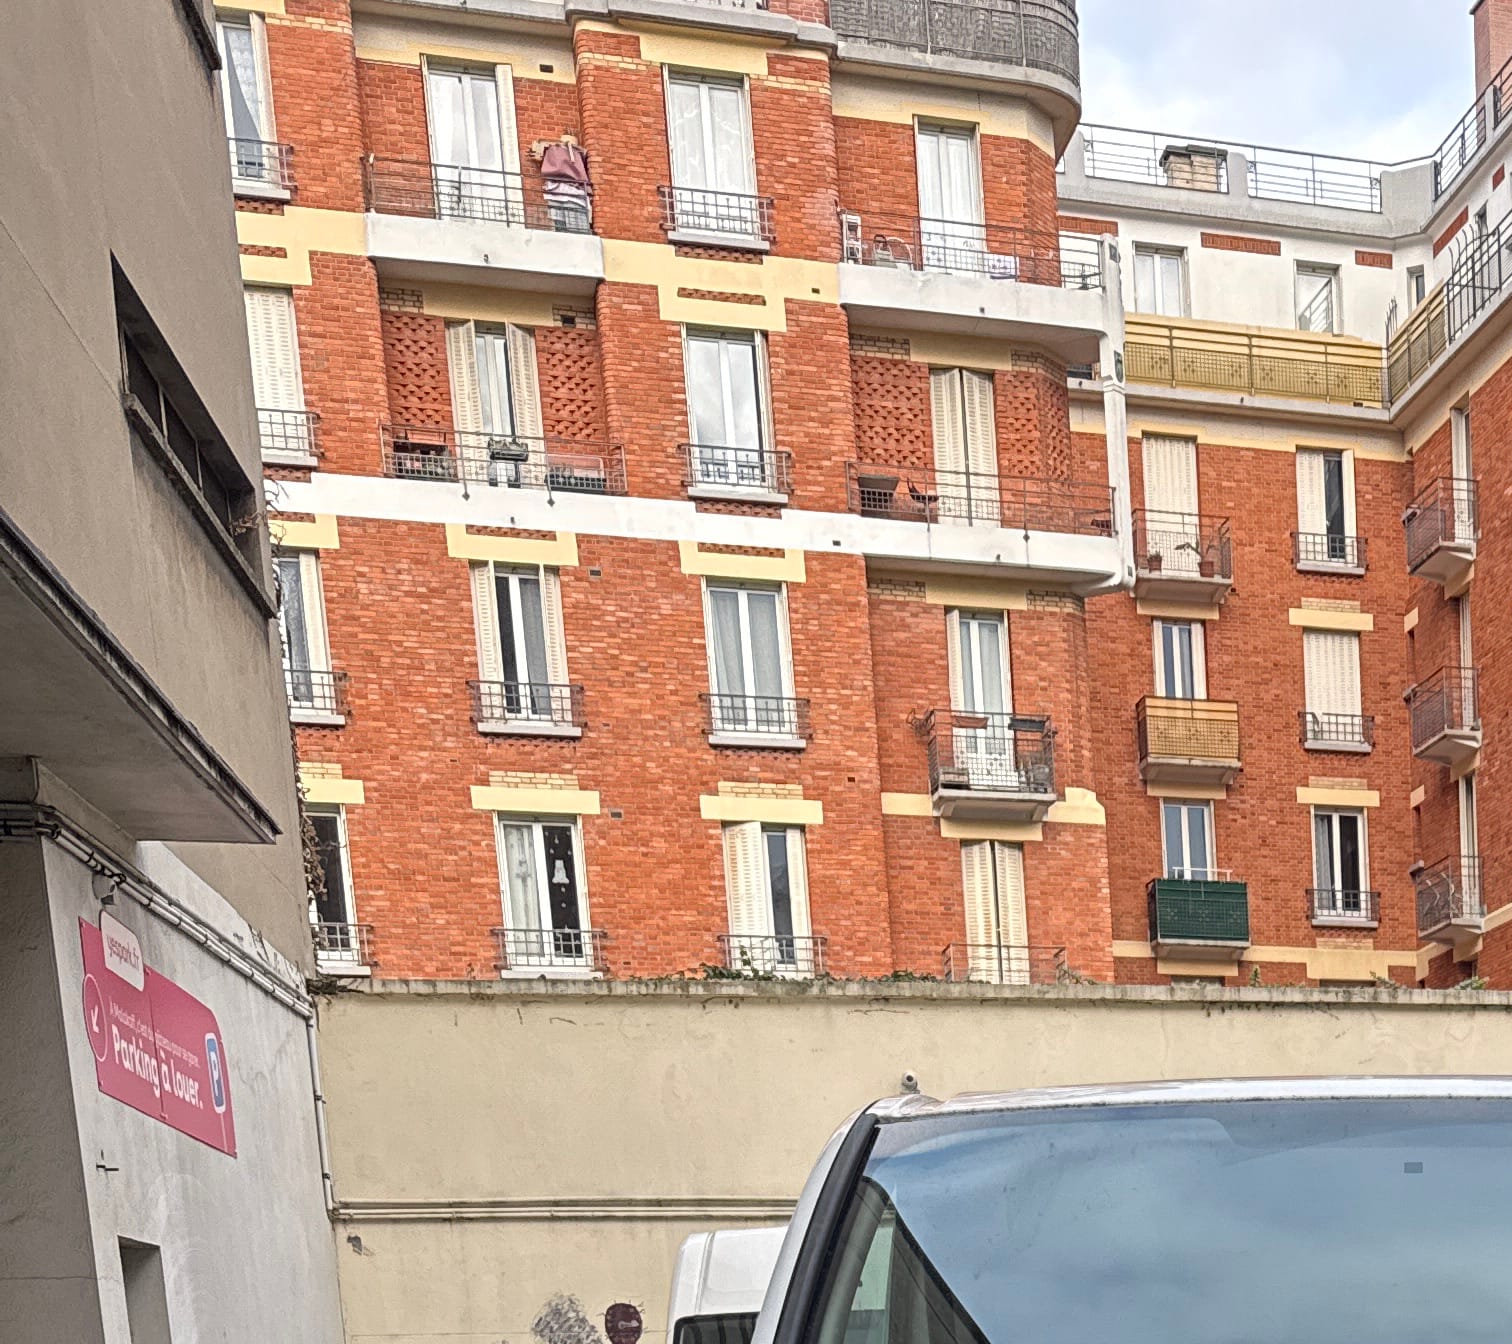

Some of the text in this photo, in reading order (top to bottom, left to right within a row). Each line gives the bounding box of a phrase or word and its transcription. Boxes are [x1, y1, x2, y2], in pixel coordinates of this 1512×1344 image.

[112, 1023, 204, 1110] Parking à louer.
[209, 1050, 219, 1097] P
